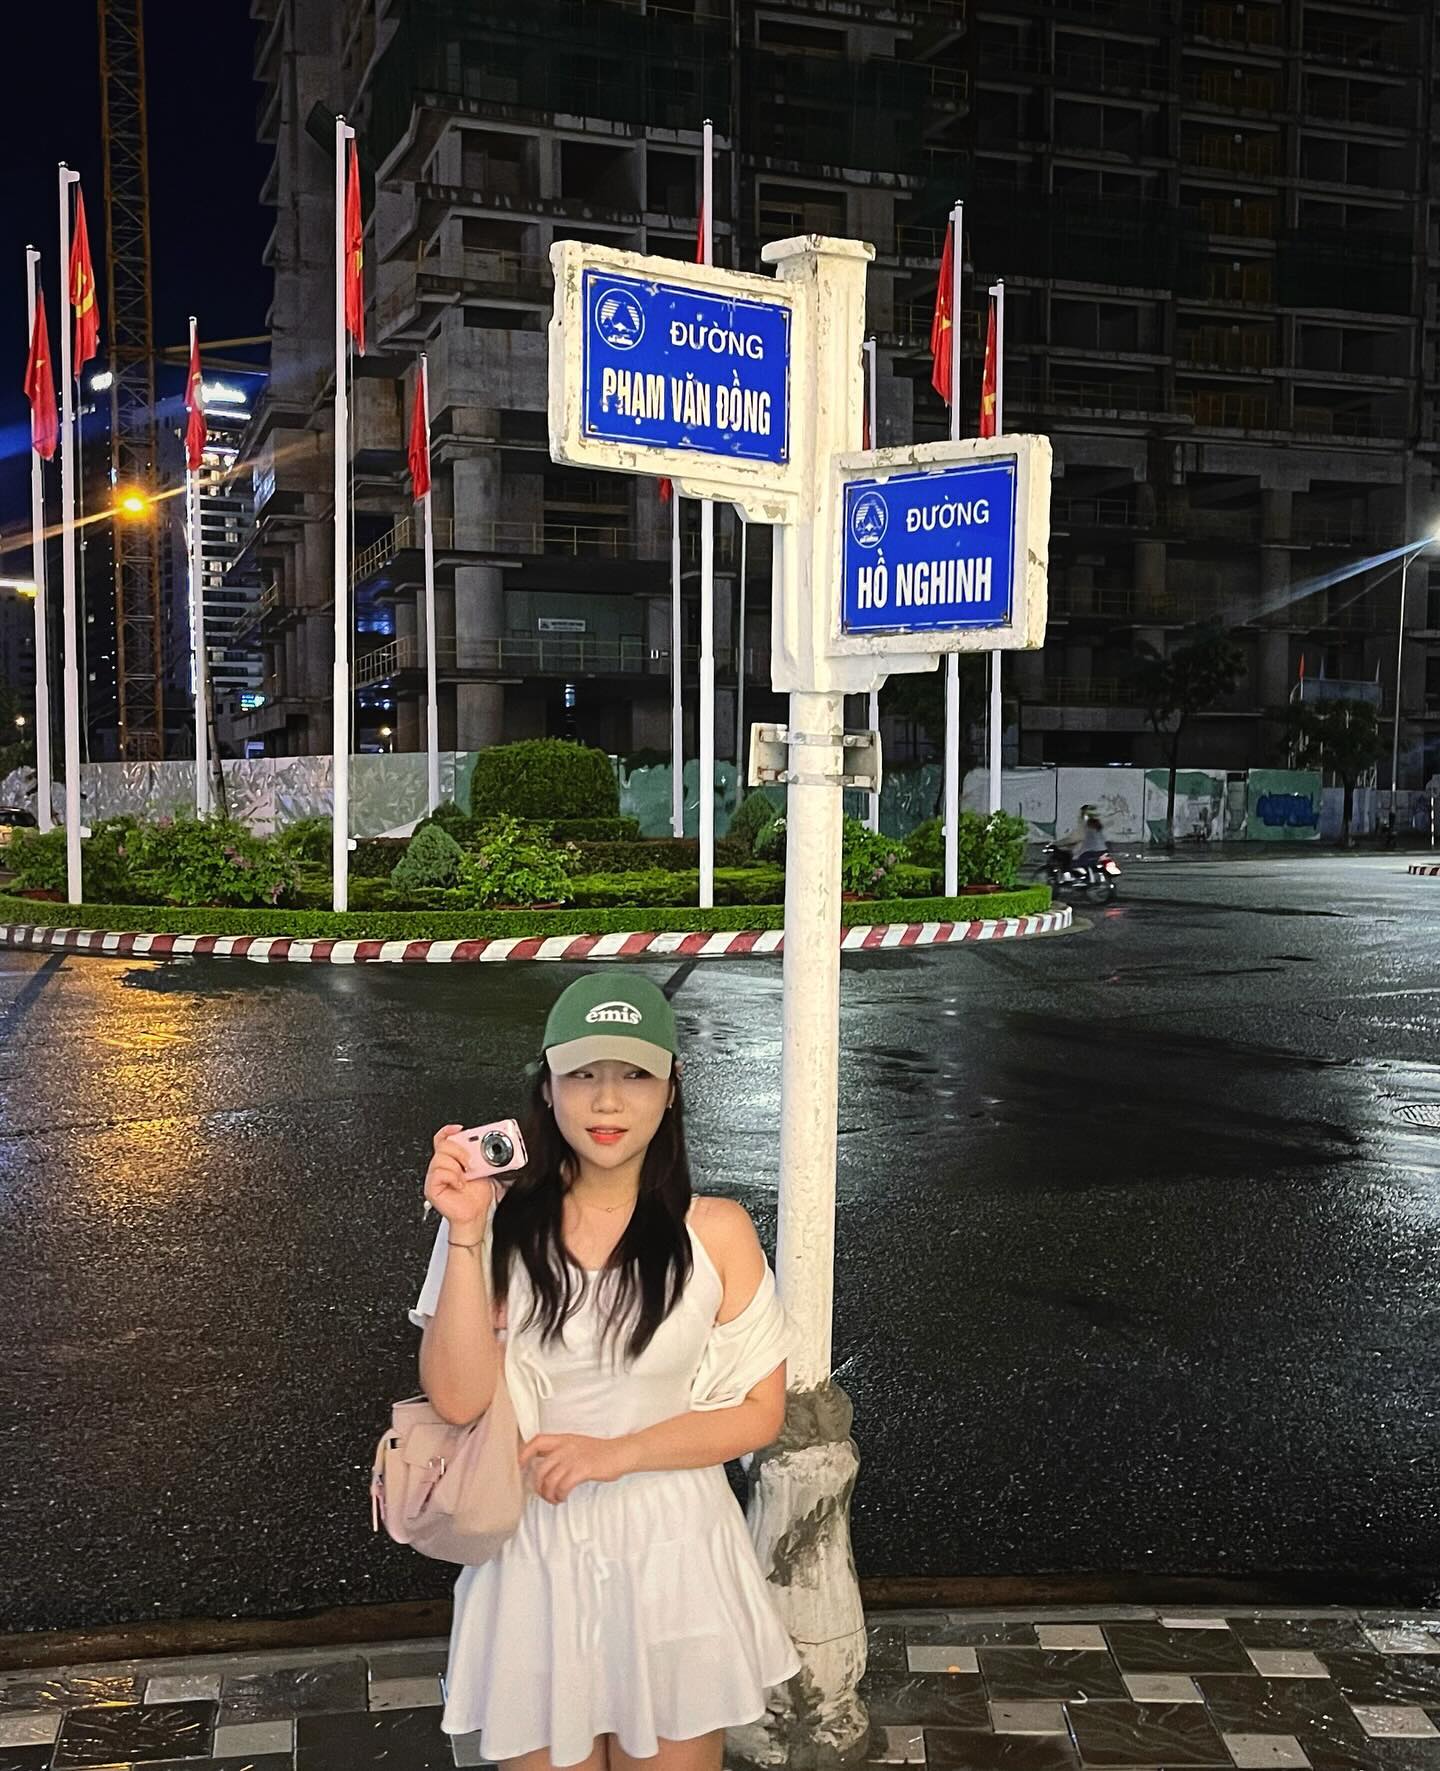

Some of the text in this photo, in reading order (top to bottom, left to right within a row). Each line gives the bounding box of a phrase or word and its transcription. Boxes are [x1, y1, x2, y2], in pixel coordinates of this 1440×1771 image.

[669, 320, 764, 360] ĐƯỜNG
[602, 367, 771, 436] PHẠM VĂN ĐỒNG
[906, 495, 990, 533] ĐƯỜNG
[858, 547, 992, 609] HỒ NGHINH
[585, 1006, 640, 1025] emis
